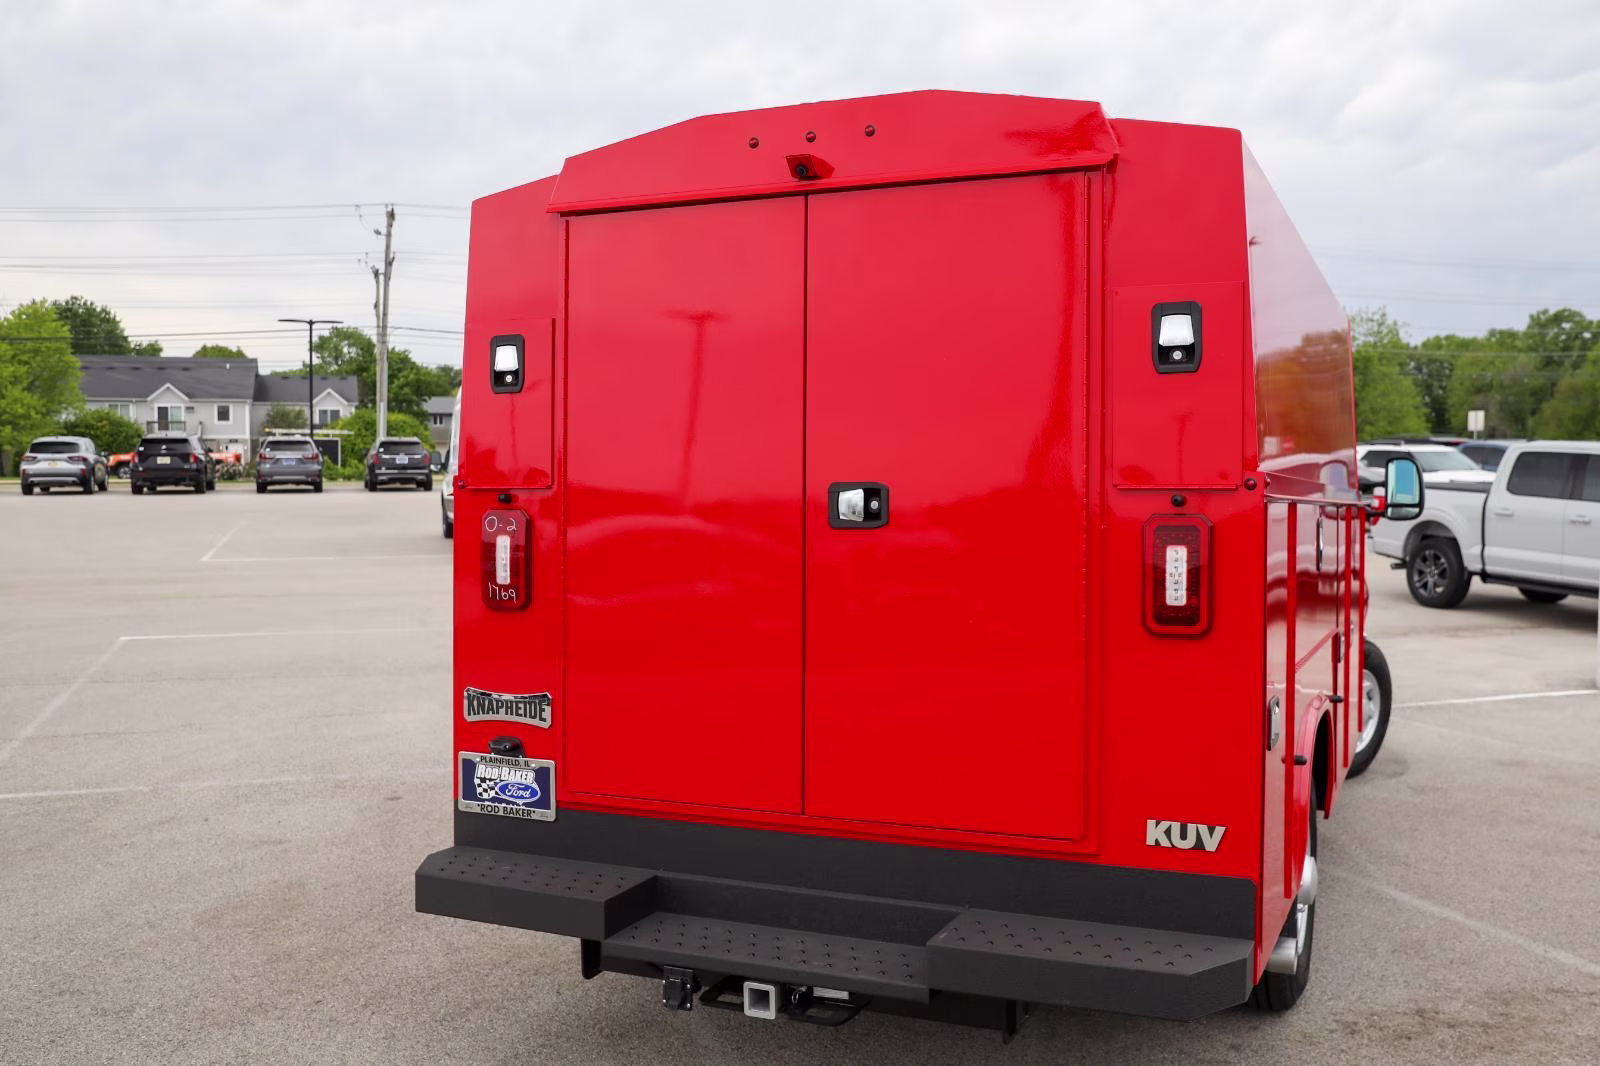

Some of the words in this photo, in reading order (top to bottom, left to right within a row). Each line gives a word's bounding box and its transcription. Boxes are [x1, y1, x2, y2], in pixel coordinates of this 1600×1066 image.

[488, 581, 517, 604] 1769
[467, 692, 547, 722] KNAPHEIDE
[524, 760, 530, 768] IL
[505, 783, 531, 798] Ford
[1145, 818, 1226, 852] KUV
